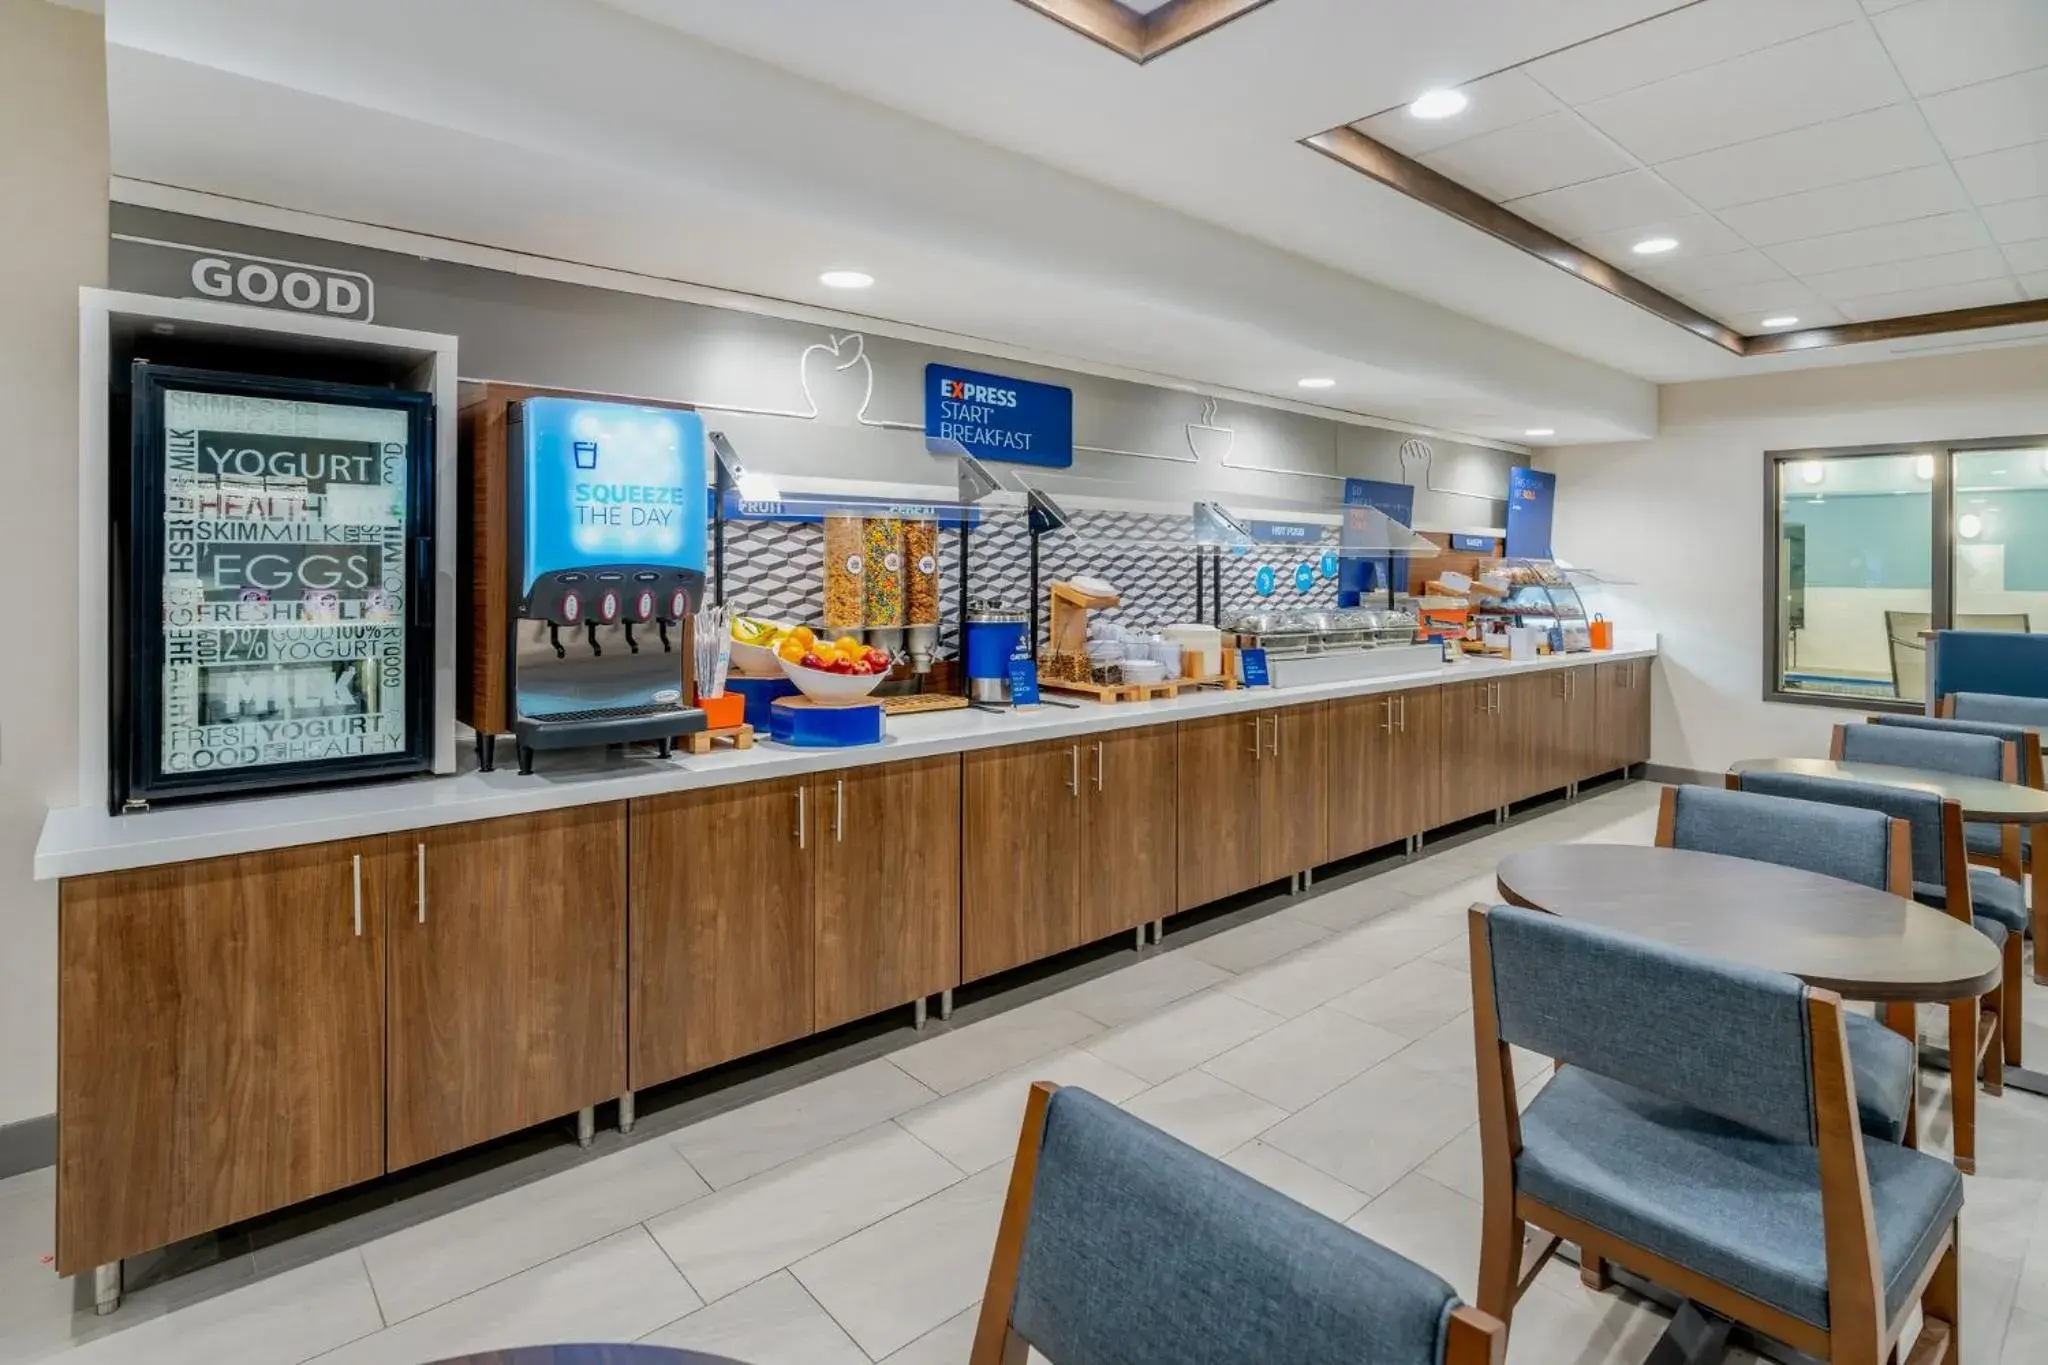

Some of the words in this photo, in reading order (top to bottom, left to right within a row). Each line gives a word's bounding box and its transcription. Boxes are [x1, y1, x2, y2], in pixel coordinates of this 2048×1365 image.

[191, 258, 362, 314] GOOD
[940, 378, 1017, 408] EXPRESS
[168, 428, 196, 472] MILK
[940, 421, 1033, 451] BREAKFAST
[206, 446, 374, 481] YOGURT
[575, 483, 684, 506] SQUEEZE
[739, 499, 782, 515] FRUIT
[575, 505, 622, 526] THE
[631, 506, 673, 527] DAY
[213, 554, 370, 590] EGGS
[382, 564, 402, 646] YOGRT
[223, 627, 267, 661] 2%
[272, 639, 380, 660] YOGURT
[226, 665, 358, 714] MILK
